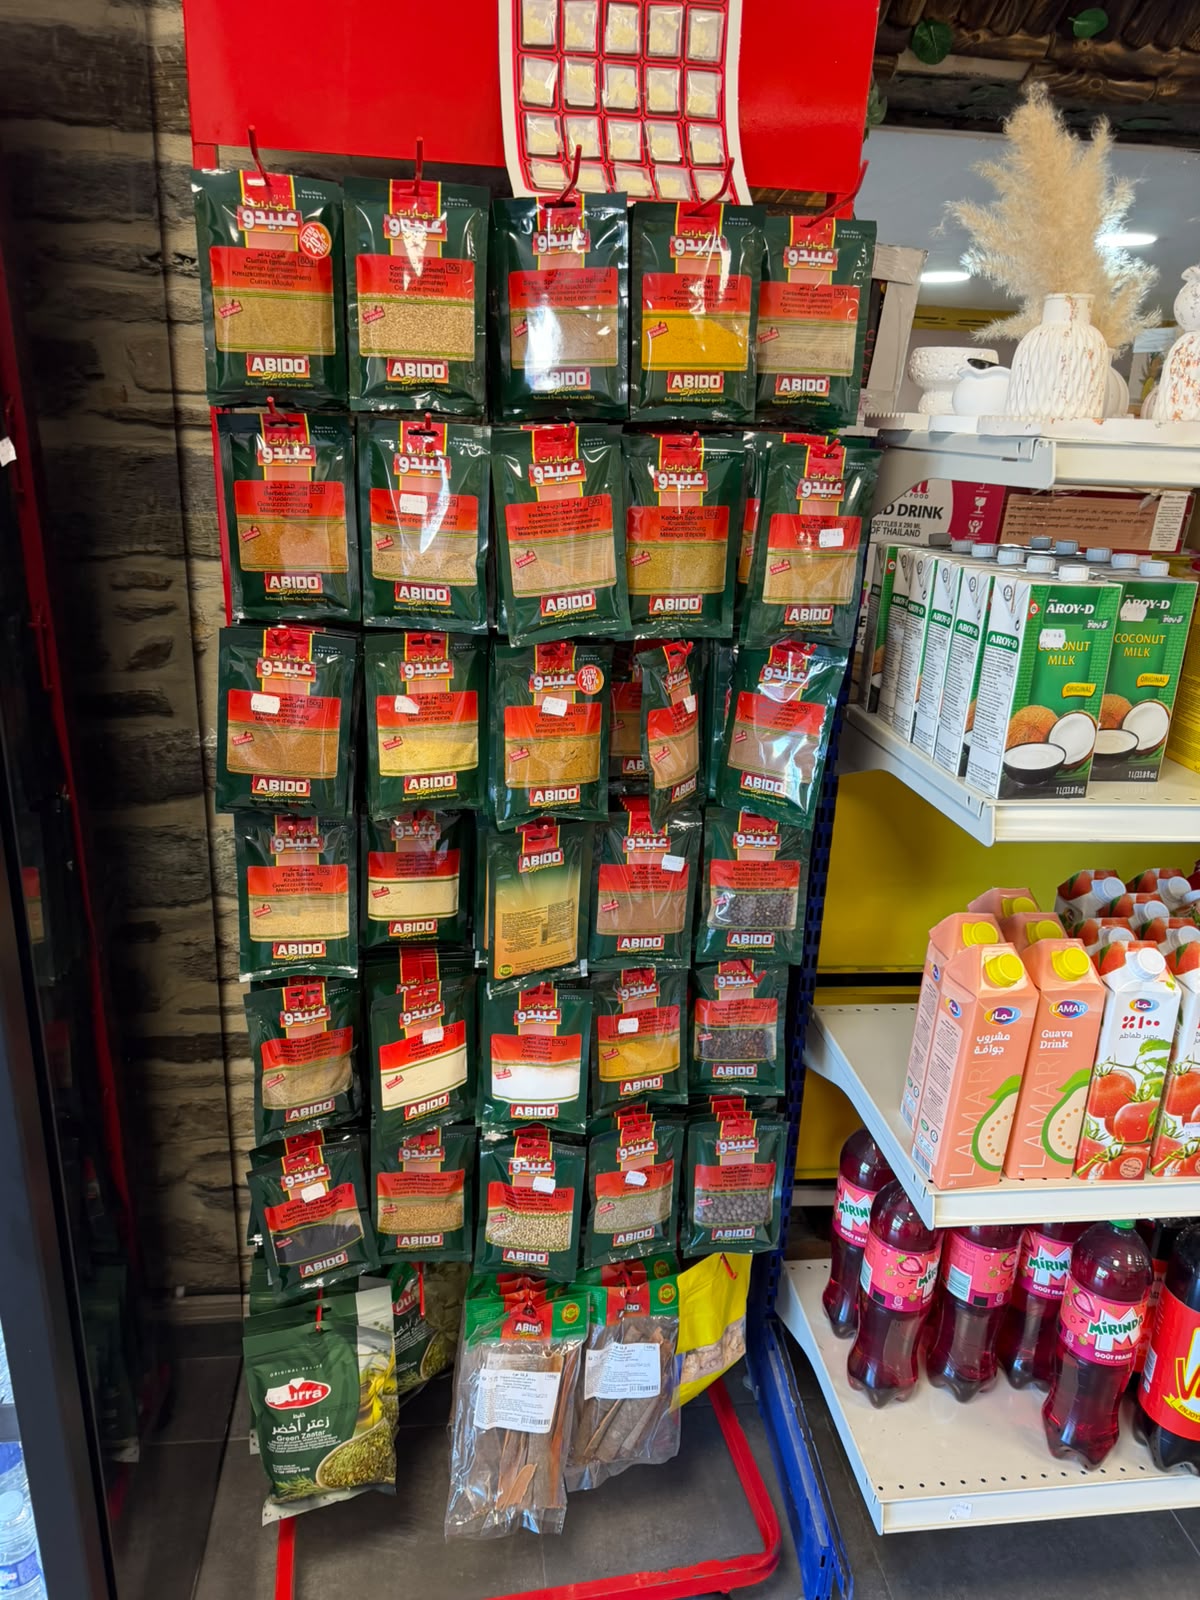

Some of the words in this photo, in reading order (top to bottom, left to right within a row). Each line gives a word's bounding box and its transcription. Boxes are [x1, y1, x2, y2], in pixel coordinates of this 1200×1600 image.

[242, 210, 298, 230] عبيدو
[788, 248, 833, 266] عبيدو
[252, 358, 306, 373] ABIDO
[392, 362, 446, 378] ABIDO
[672, 374, 721, 389] ABIDO
[780, 378, 827, 392] ABIDO
[262, 446, 312, 464] عبيدو
[533, 463, 582, 484] عبيدو
[658, 472, 704, 489] عبيدو
[801, 481, 842, 499] عبيدو
[897, 504, 944, 520] DRINK
[882, 527, 920, 537] THAILAND
[269, 576, 319, 590] ABIDO
[399, 586, 448, 600] ABIDO
[546, 594, 592, 612] ABIDO
[654, 596, 701, 610] ABIDO
[1046, 603, 1094, 614] AROY-D
[789, 608, 830, 622] ABIDO
[990, 634, 1018, 648] AROY-D
[1114, 634, 1166, 644] COCONUT
[1124, 648, 1150, 658] MILK
[1047, 656, 1075, 666] MILK
[261, 660, 312, 678] عبيدو
[404, 661, 450, 680] عبيدو
[534, 673, 577, 690] عبيدو
[582, 675, 600, 686] 20%
[256, 778, 307, 792] ABIDO
[408, 776, 455, 790] ABIDO
[744, 775, 785, 792] ABIDO
[534, 788, 578, 802] ABIDO
[273, 836, 320, 852] عبيدو
[626, 836, 668, 851] عبيدو
[736, 834, 778, 848] عبيدو
[521, 852, 562, 868] ABIDO
[392, 922, 435, 934] ABIDO
[620, 936, 662, 948] ABIDO
[730, 933, 772, 945] ABIDO
[276, 942, 323, 956] ABIDO
[620, 982, 657, 1000] عبيدو
[402, 1002, 442, 1024] عبيدو
[988, 1009, 1016, 1022] لمار
[1052, 1003, 1086, 1014] LAMAR
[284, 1006, 328, 1026] عبيدو
[518, 1008, 558, 1024] عبيدو
[976, 1032, 1010, 1044] مشروب
[1041, 1030, 1073, 1038] Guava
[974, 1044, 1004, 1055] جوافة
[1040, 1040, 1068, 1050] Drink
[716, 1066, 755, 1076] ABIDO
[623, 1078, 661, 1093] ABIDO
[290, 1100, 333, 1120] ABIDO
[408, 1095, 448, 1116] ABIDO
[514, 1106, 556, 1117] ABIDO
[620, 1140, 655, 1160] عبيدو
[718, 1138, 756, 1154] عبيدو
[512, 1160, 552, 1174] عبيدو
[285, 1166, 327, 1188] عبيدو
[400, 1235, 441, 1246] ABIDO
[616, 1228, 652, 1244] ABIDO
[714, 1228, 754, 1239] ABIDO
[304, 1253, 346, 1274] ABIDO
[506, 1251, 546, 1262] ABIDO
[1095, 1352, 1114, 1360] GOÛT
[272, 1419, 301, 1435] أخضر
[306, 1416, 330, 1432] زعتر
[301, 1430, 326, 1439] Zaatar
